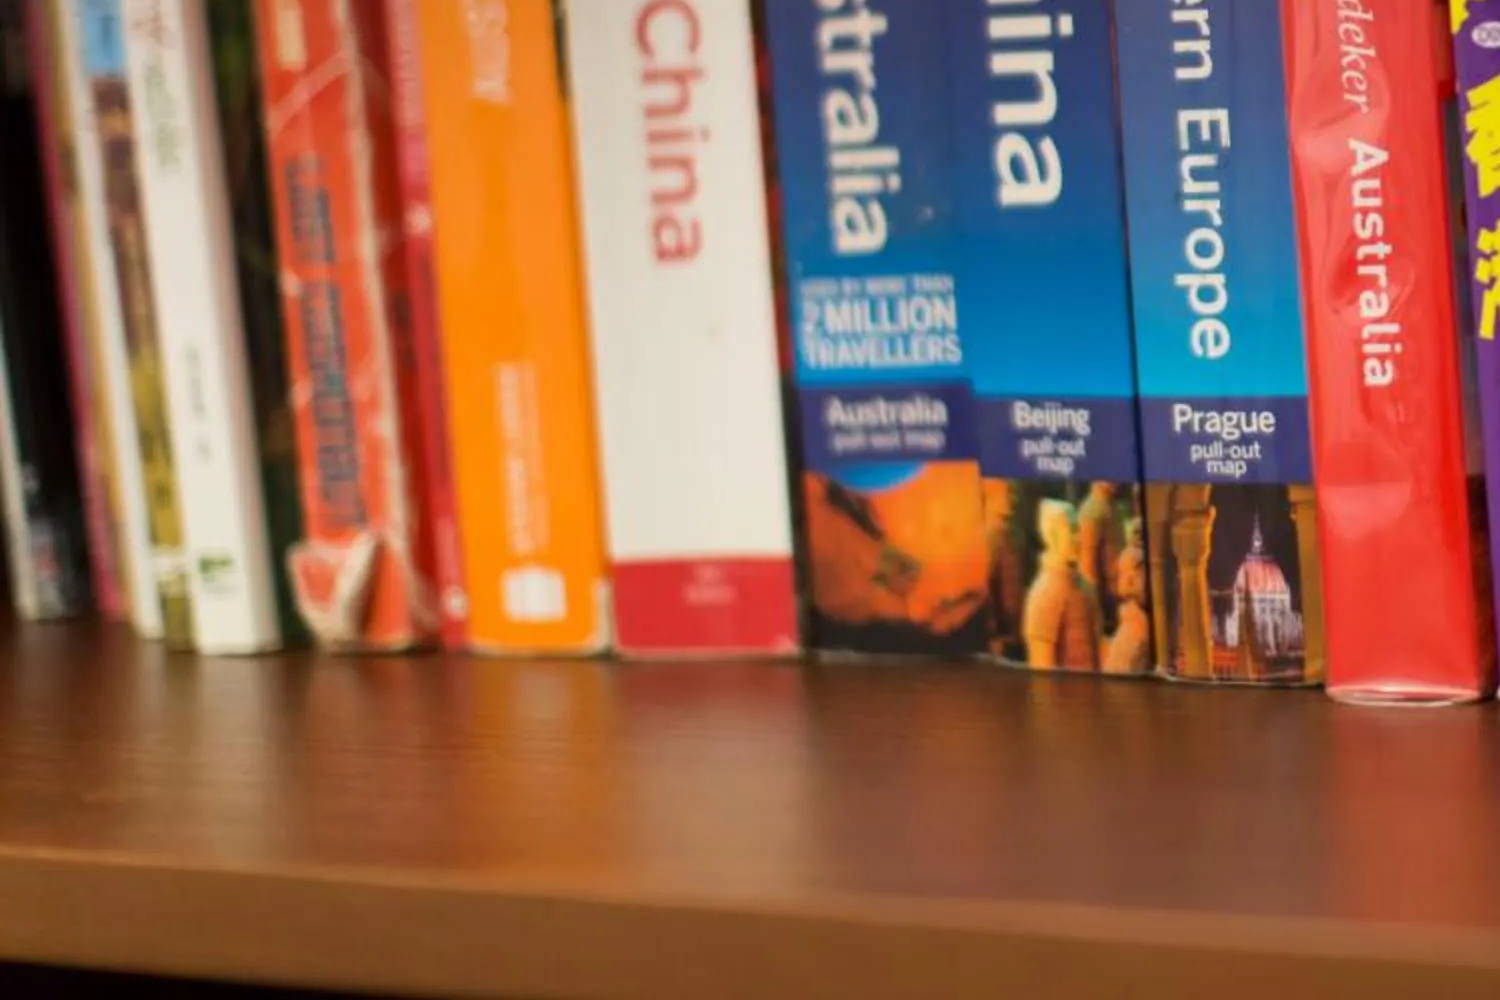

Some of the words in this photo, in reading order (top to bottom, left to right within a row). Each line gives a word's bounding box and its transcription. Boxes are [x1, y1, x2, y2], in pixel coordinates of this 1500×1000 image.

[1174, 107, 1231, 360] Europe
[1348, 138, 1402, 388] Australia
[824, 295, 957, 335] MILLION
[804, 333, 963, 371] TRAVELLERS
[827, 394, 948, 428] Australia
[1013, 399, 1091, 436] Beijing
[1172, 403, 1276, 440] Prague
[1036, 456, 1075, 475] map
[1190, 441, 1262, 463] pull-out
[1206, 461, 1248, 478] map
